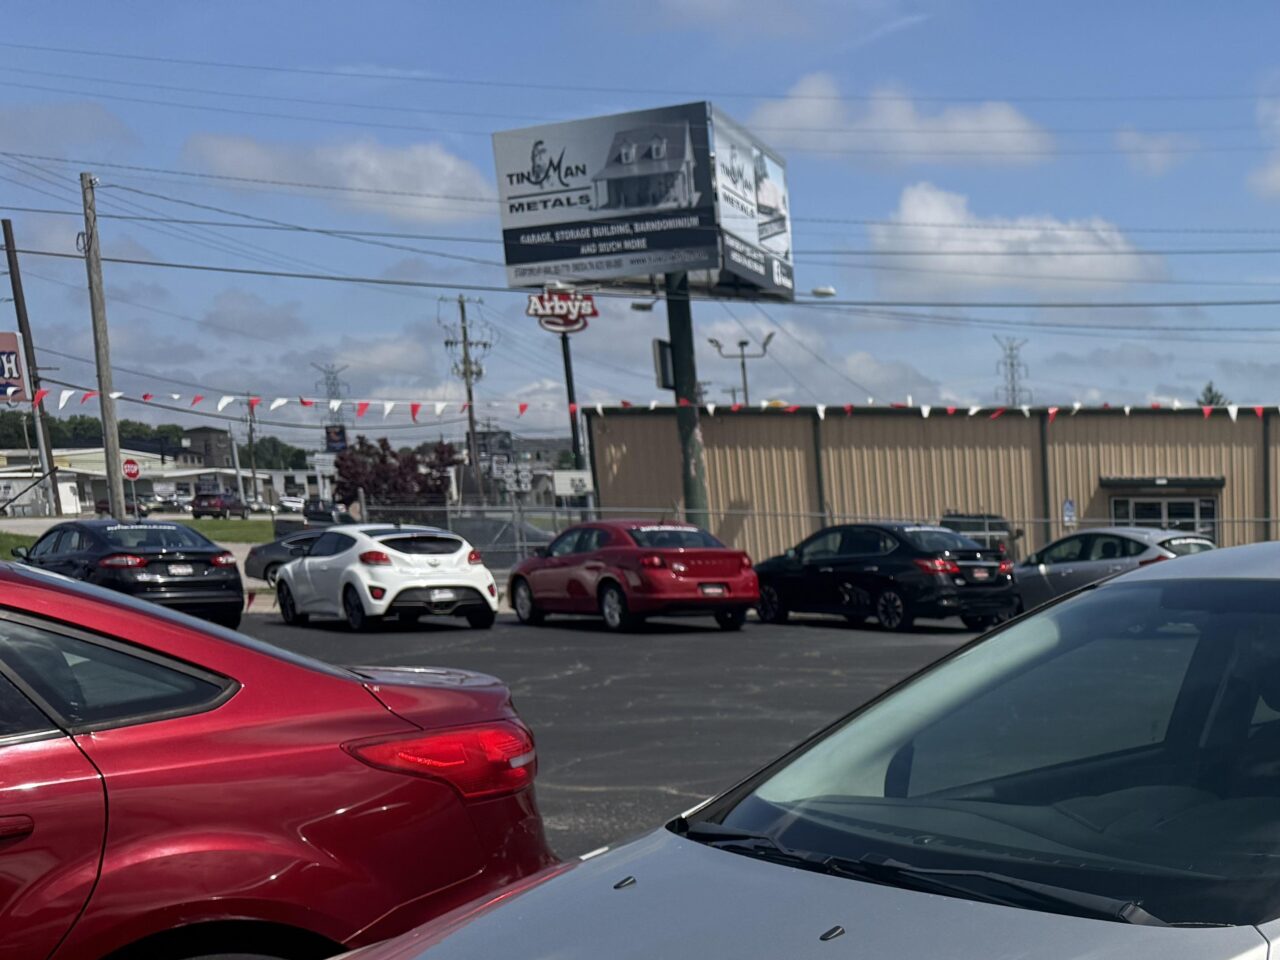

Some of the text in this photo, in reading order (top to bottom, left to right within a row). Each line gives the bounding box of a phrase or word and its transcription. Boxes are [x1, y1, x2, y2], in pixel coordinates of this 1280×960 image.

[506, 171, 531, 186] TIN
[509, 194, 591, 213] METALS
[520, 216, 699, 245] GARAGE, STORAGE BUILDING, BARNDOMINIUM
[581, 237, 647, 255] AND MUCH MORE
[528, 294, 593, 320] Arby's
[123, 463, 138, 474] STOP
